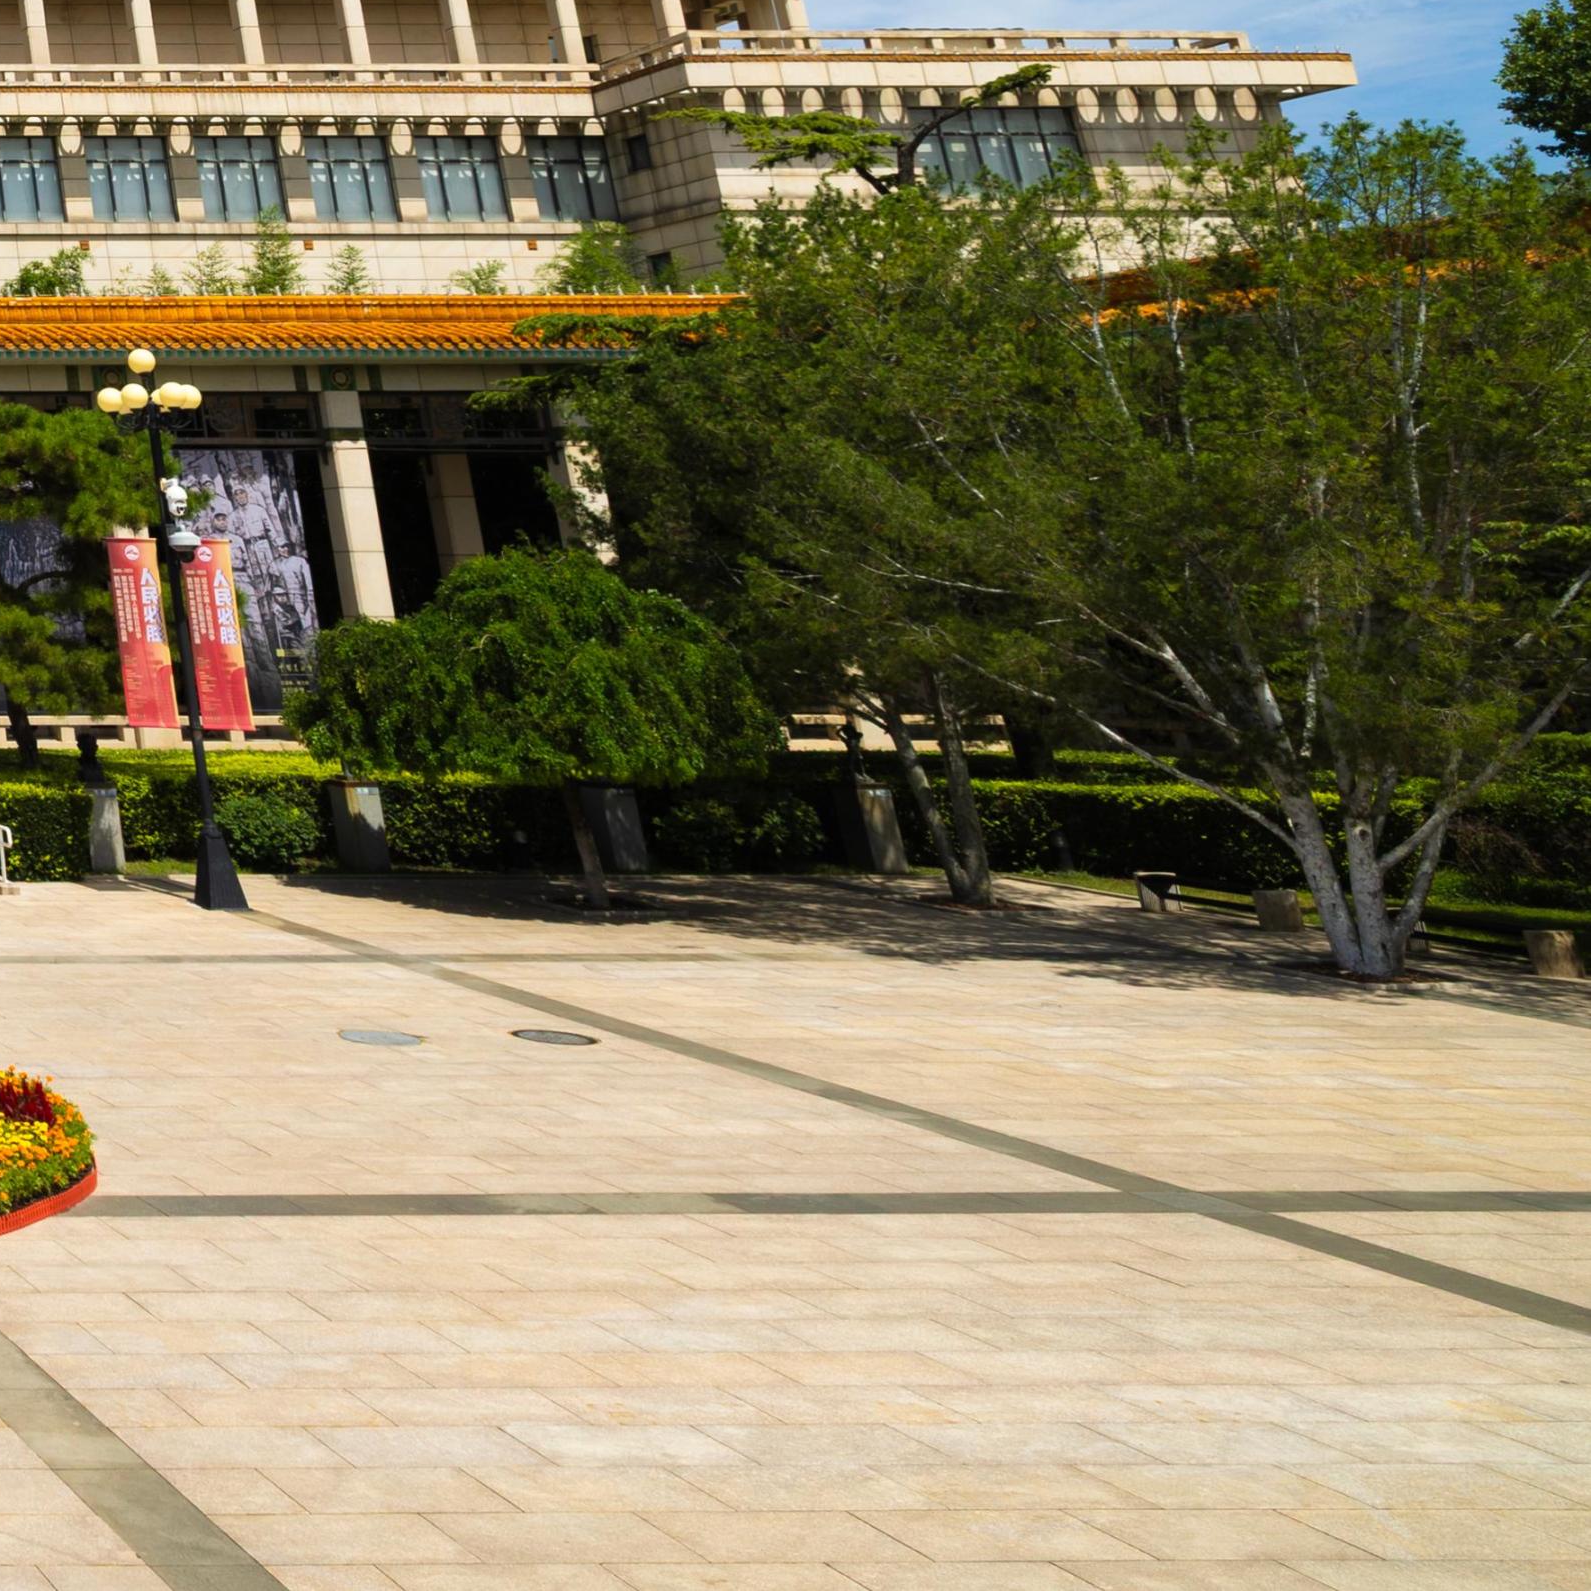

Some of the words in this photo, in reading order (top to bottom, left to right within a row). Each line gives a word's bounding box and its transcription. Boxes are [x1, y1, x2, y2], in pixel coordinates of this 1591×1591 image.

[140, 567, 165, 643] 人民必胜
[213, 568, 239, 644] 人民必胜
